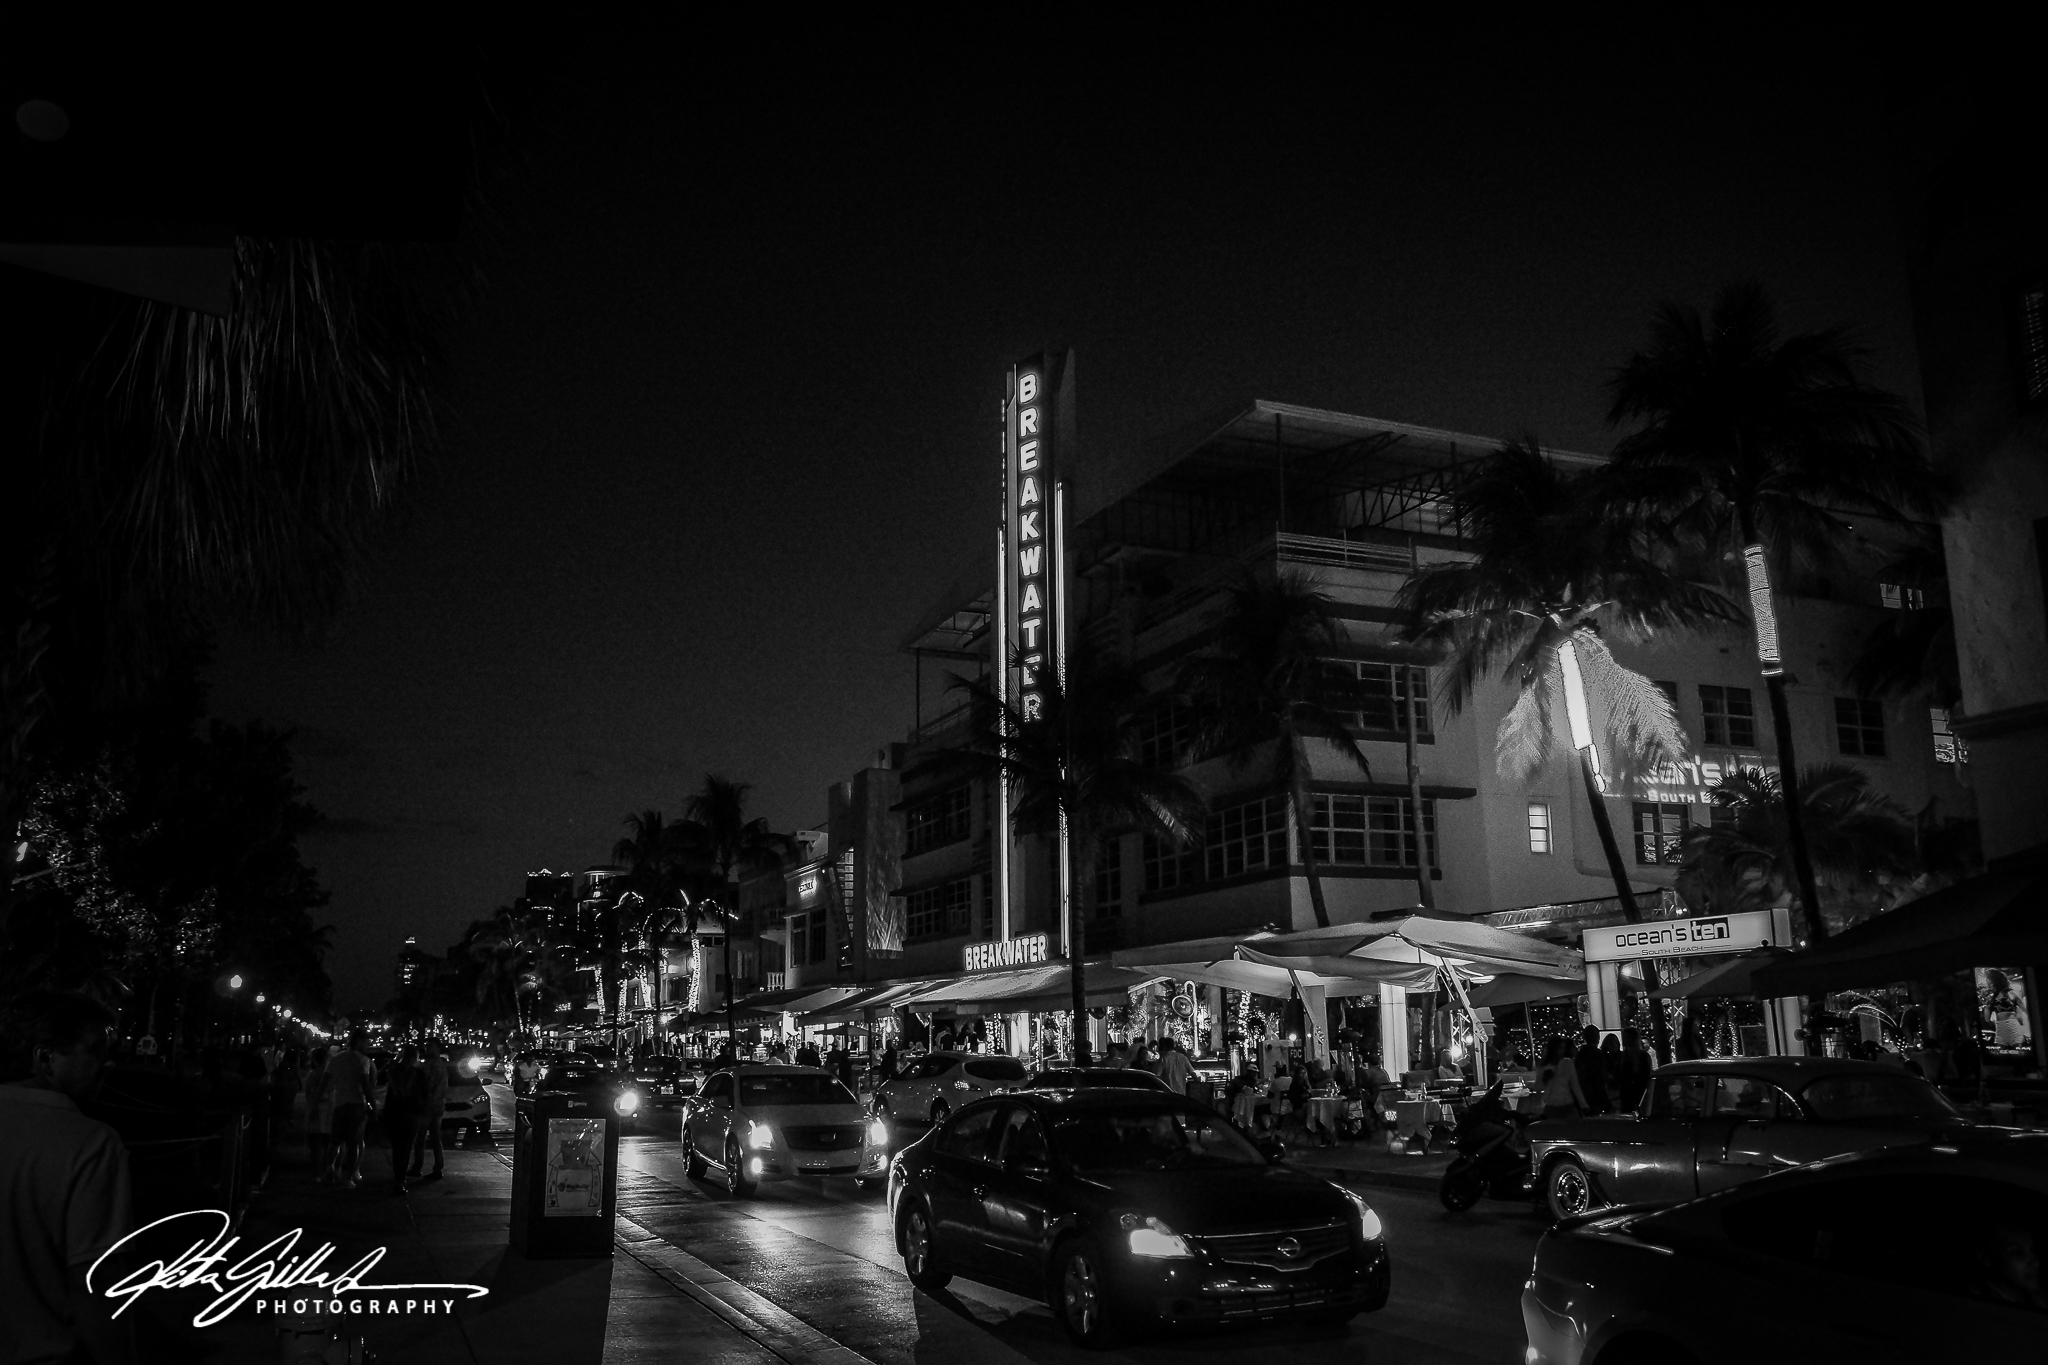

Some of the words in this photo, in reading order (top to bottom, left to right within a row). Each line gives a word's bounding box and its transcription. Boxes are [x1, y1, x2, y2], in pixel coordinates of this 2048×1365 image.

[1615, 924, 1687, 948] ocean's
[1691, 920, 1728, 941] ten
[965, 935, 1047, 971] BREAKWATER
